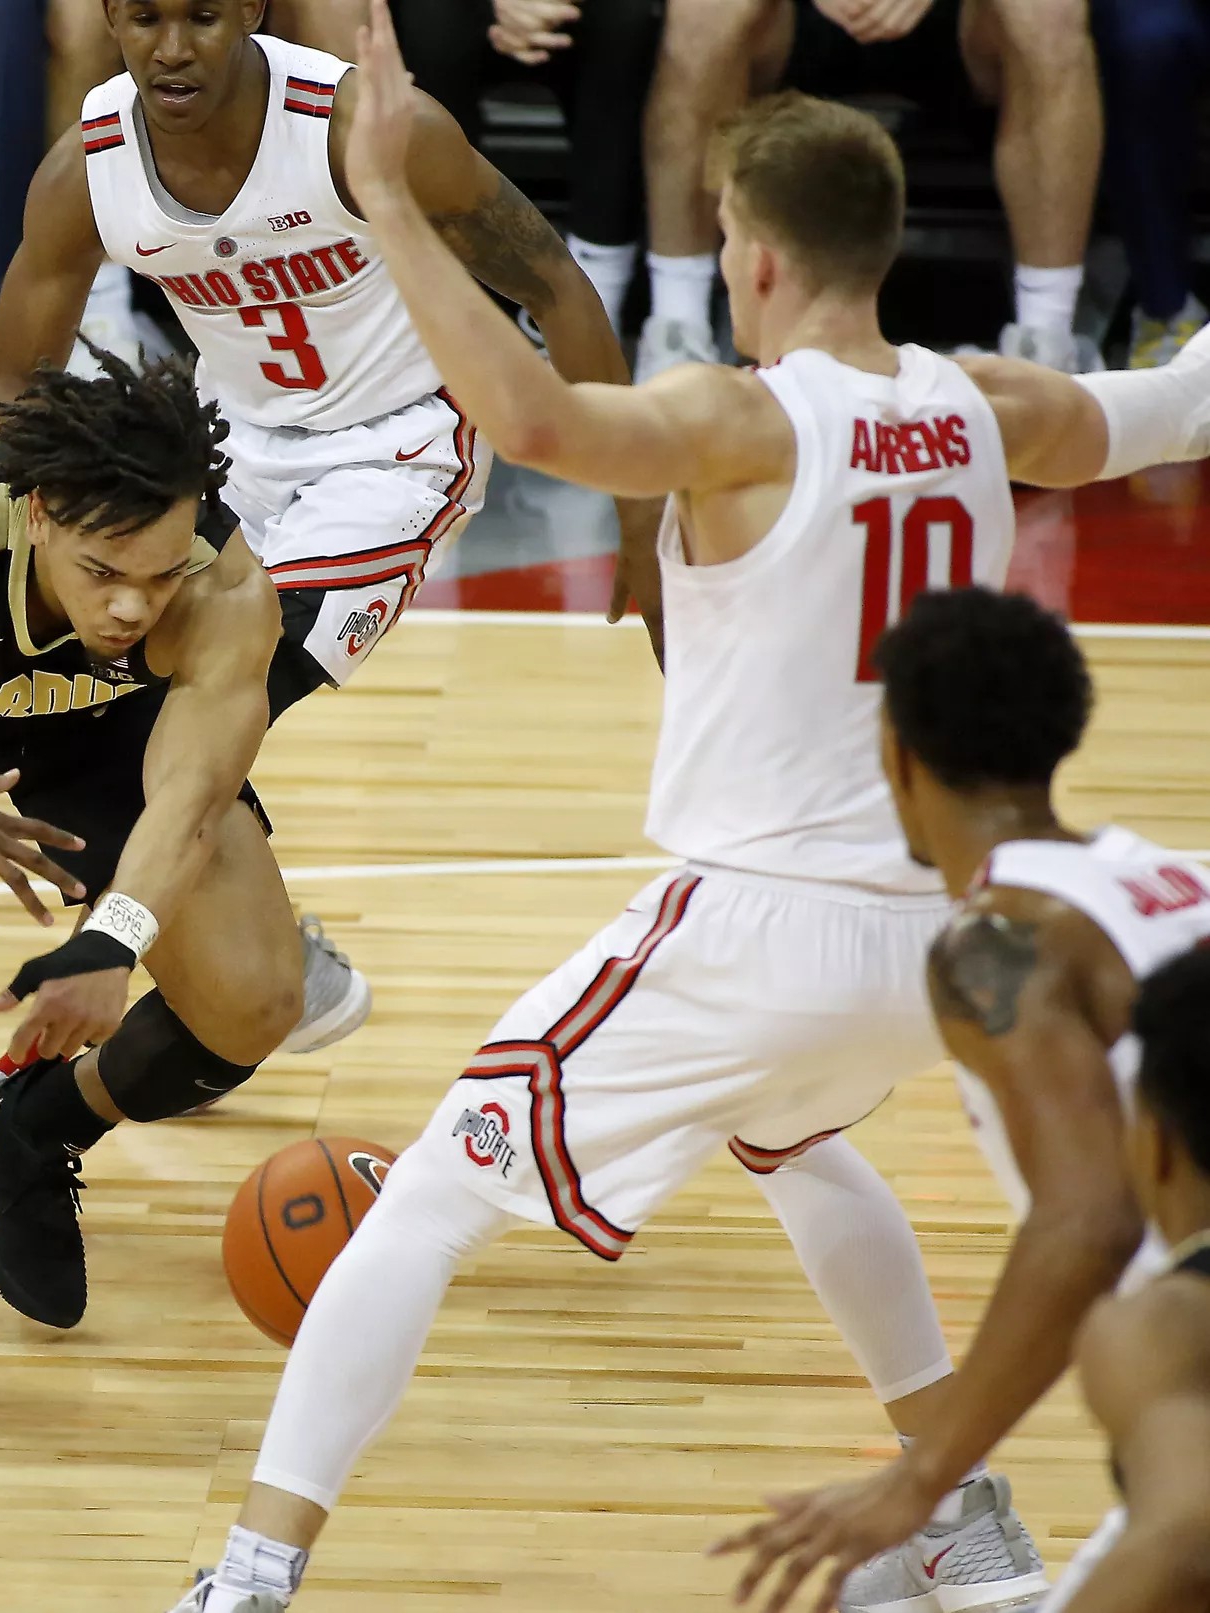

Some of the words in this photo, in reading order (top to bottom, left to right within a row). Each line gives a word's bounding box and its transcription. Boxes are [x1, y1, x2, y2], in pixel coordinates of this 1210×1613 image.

[143, 268, 243, 308] HIO
[240, 237, 370, 302] STATE
[237, 301, 328, 391] 3
[478, 1119, 518, 1179] STATE
